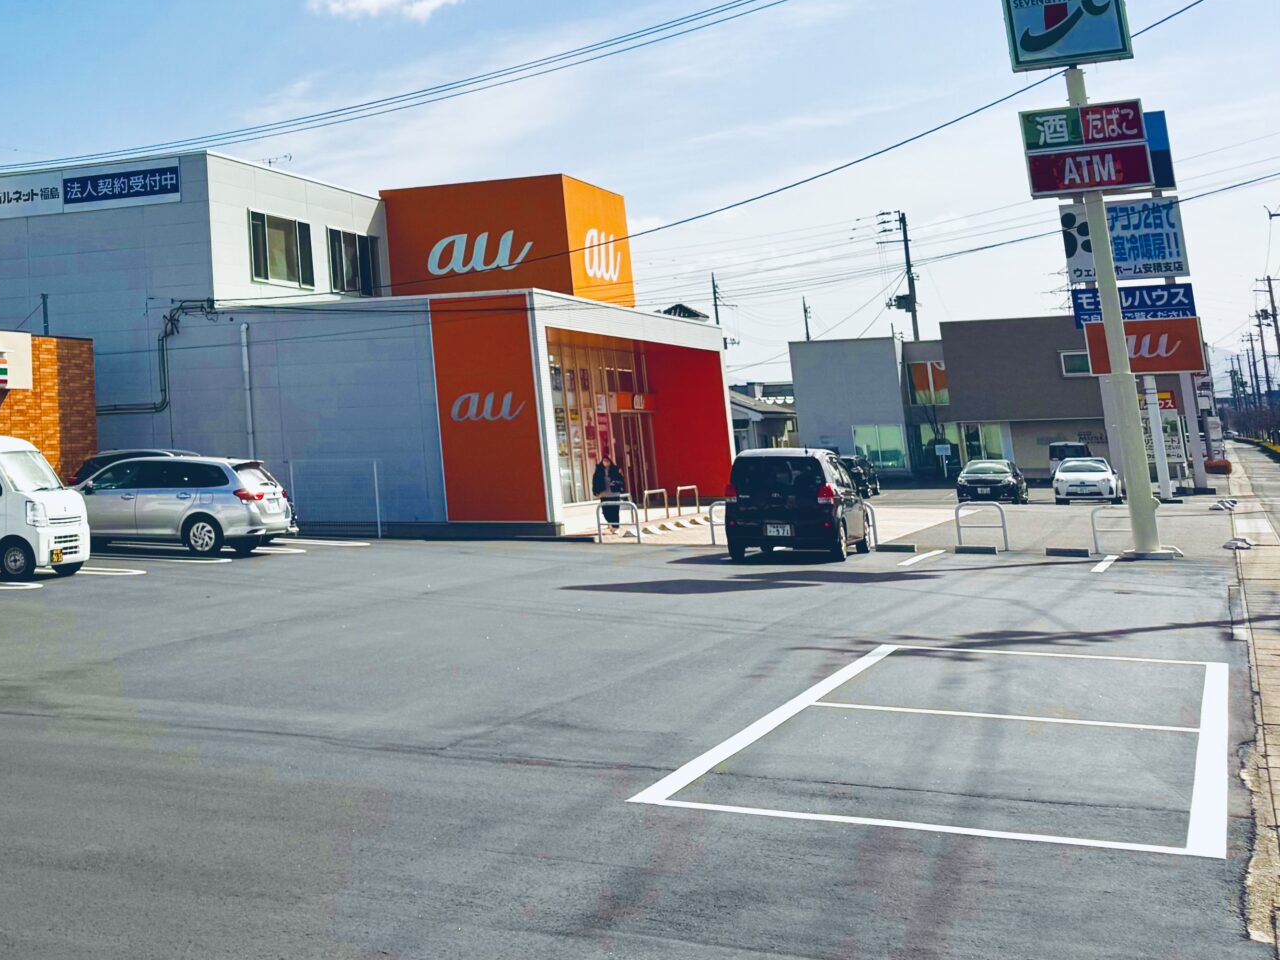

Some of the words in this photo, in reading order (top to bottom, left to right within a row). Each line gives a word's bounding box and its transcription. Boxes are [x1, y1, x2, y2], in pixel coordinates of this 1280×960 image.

[1036, 114, 1068, 145] 酒
[1086, 107, 1138, 139] たばこ
[1064, 153, 1116, 185] ATM
[67, 172, 176, 199] 法人契約受付中
[427, 230, 533, 276] au
[584, 228, 621, 281] au
[1111, 232, 1180, 262] 室冷暖房!!
[1077, 288, 1189, 310] モルハウス
[450, 391, 526, 422] au
